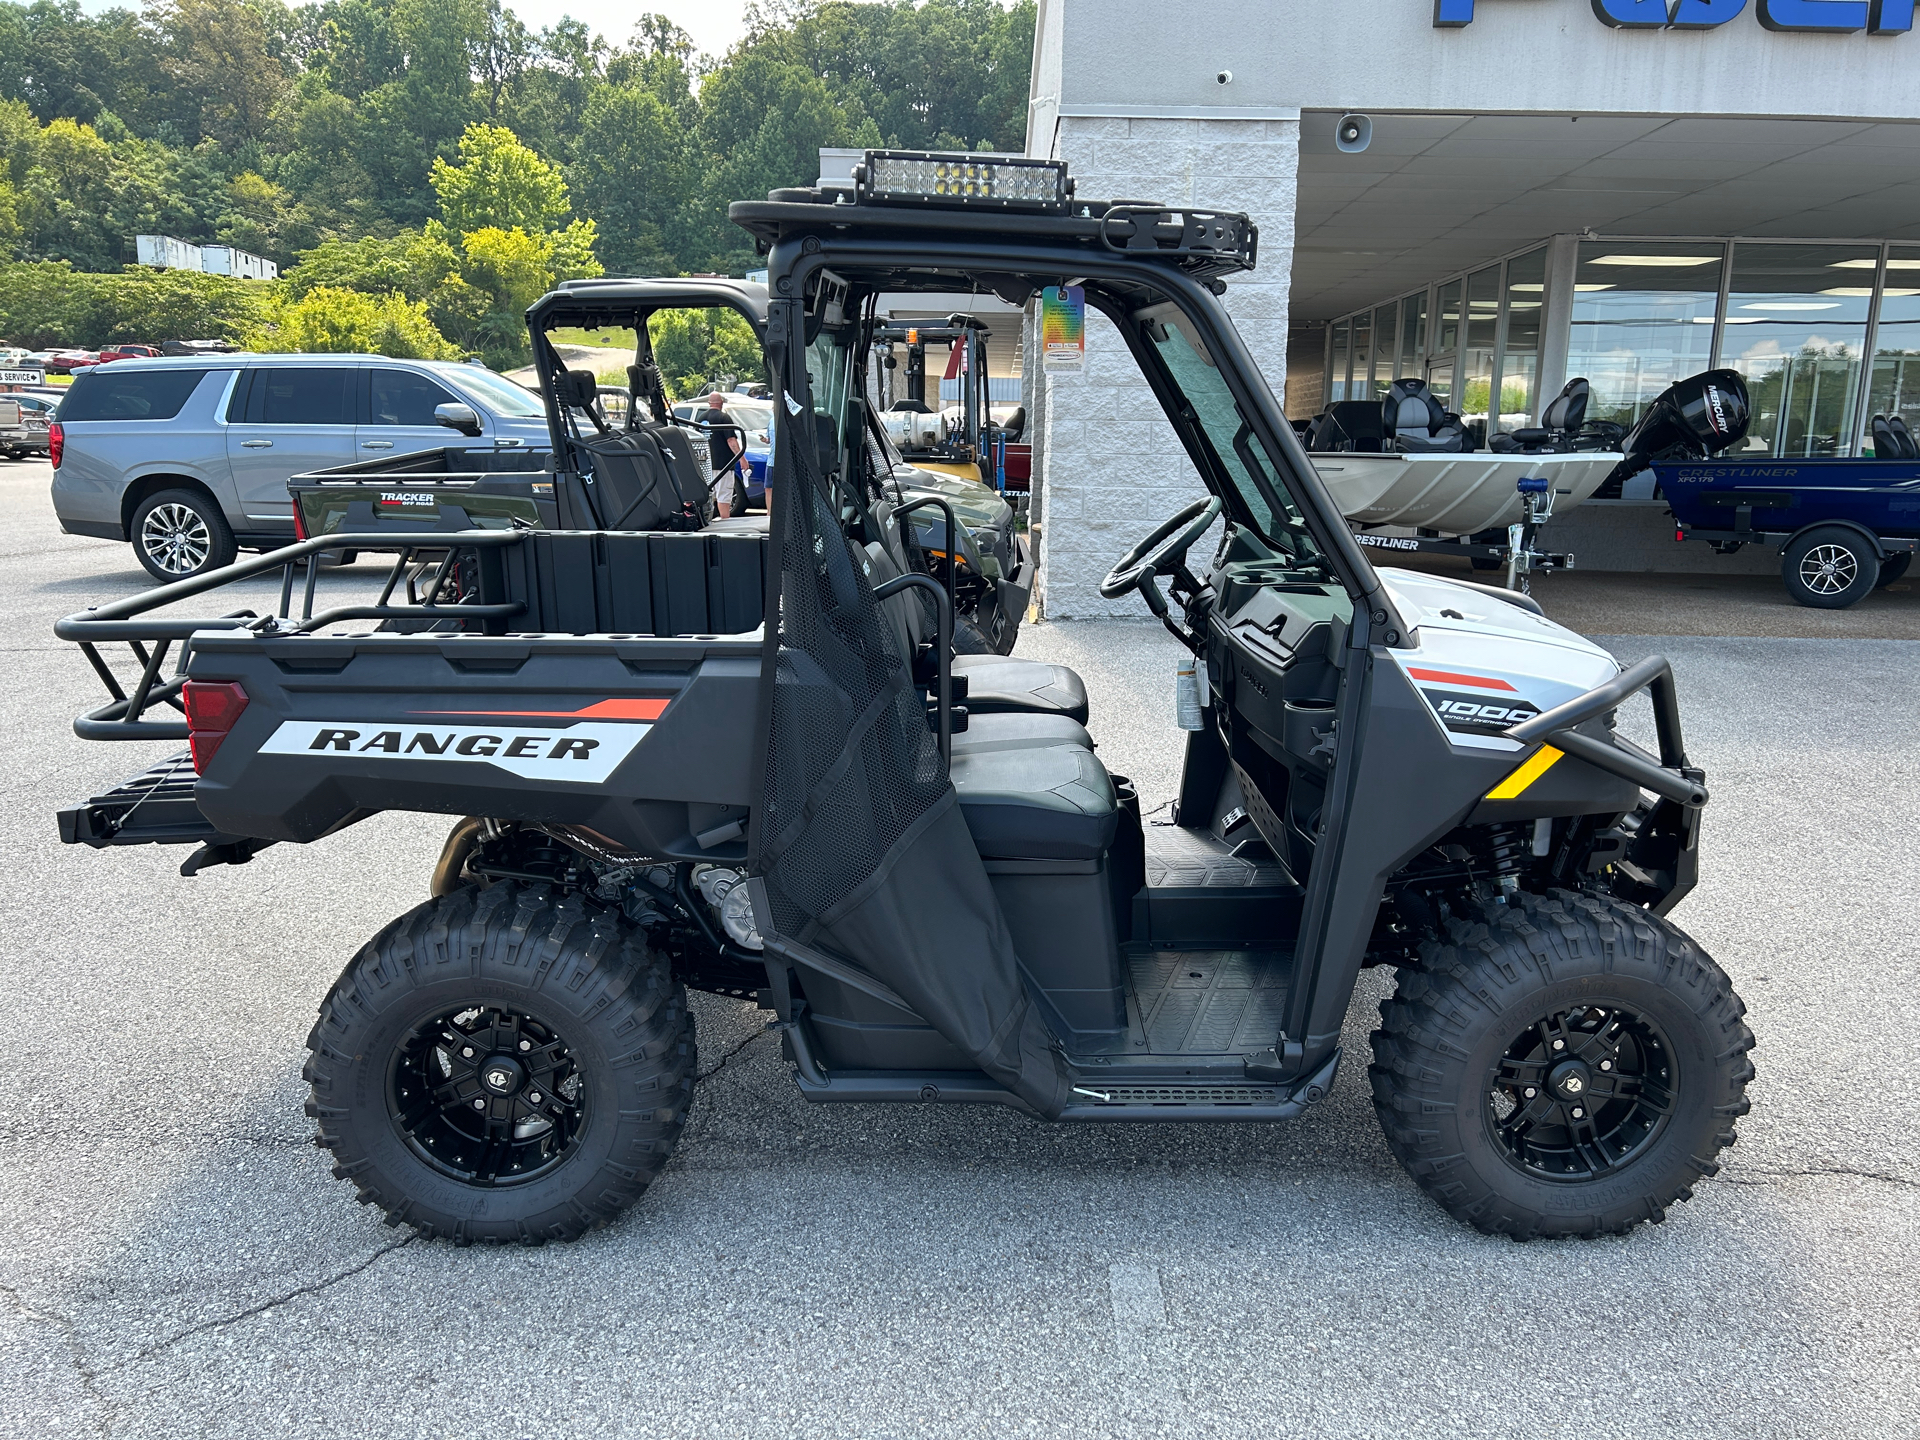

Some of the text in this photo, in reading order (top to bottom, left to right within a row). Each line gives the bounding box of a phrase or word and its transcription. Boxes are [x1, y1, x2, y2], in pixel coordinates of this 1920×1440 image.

[5, 373, 30, 381] SERVICE
[1708, 385, 1729, 433] MERCURY
[1678, 469, 1798, 477] CRESTLINER
[380, 492, 434, 502] TRACKER
[1438, 700, 1538, 722] 1000
[1443, 714, 1472, 722] SINGLE
[1473, 717, 1512, 727] OVERHEAD
[308, 729, 600, 760] RANGER
